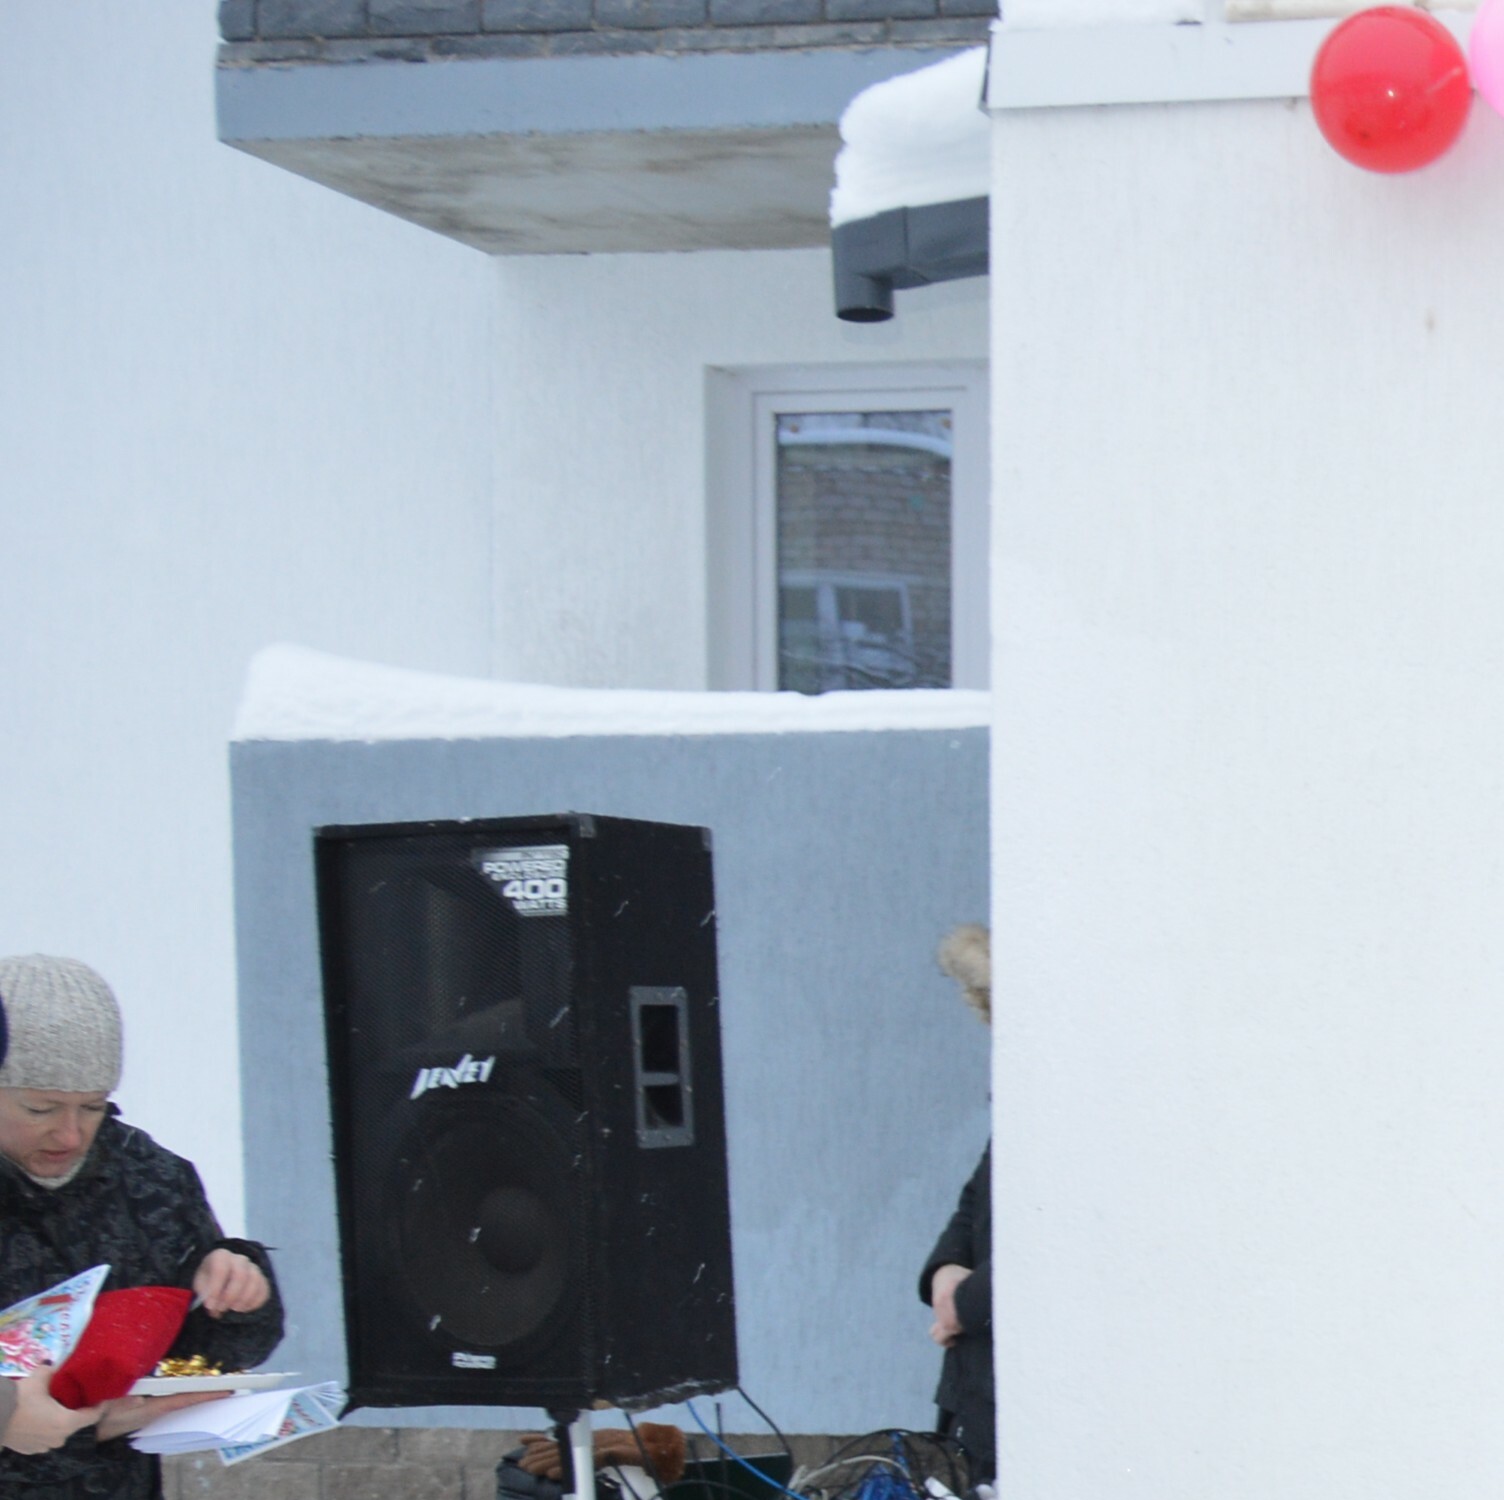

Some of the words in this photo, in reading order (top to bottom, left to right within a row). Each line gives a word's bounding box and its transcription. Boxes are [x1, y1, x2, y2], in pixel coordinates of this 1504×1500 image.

[482, 859, 567, 874] POWERED
[503, 878, 568, 900] 400
[512, 898, 568, 910] WATTS
